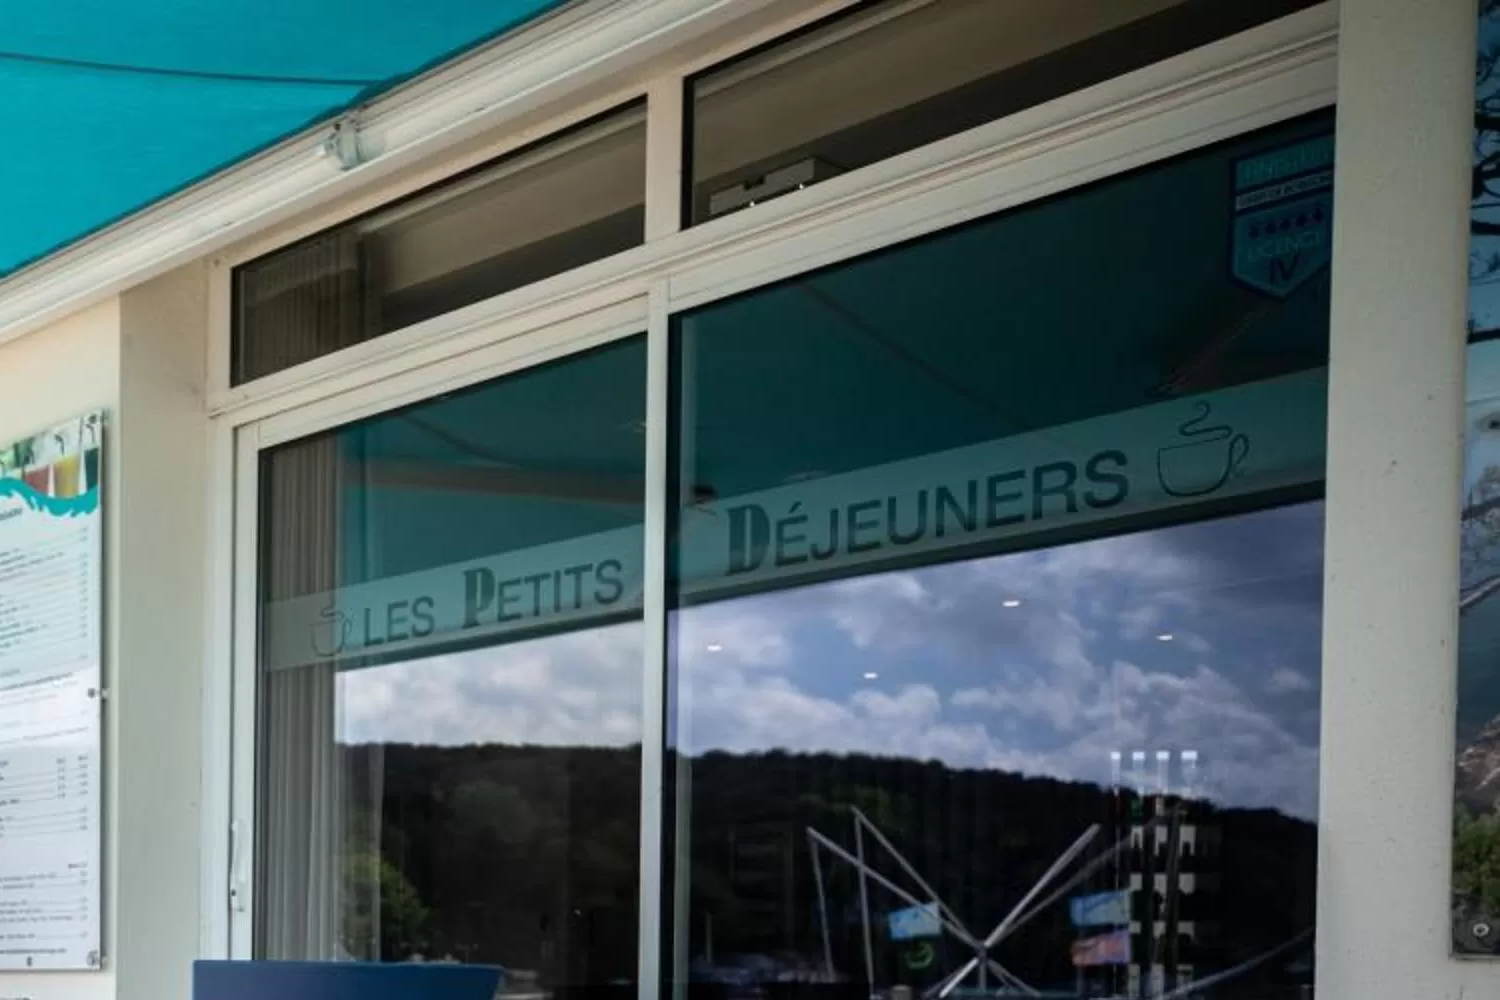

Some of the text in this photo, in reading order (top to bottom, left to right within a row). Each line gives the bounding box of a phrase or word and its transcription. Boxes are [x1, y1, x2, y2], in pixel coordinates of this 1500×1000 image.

[363, 449, 1129, 647] LES PETITS DÉJEUNERS
